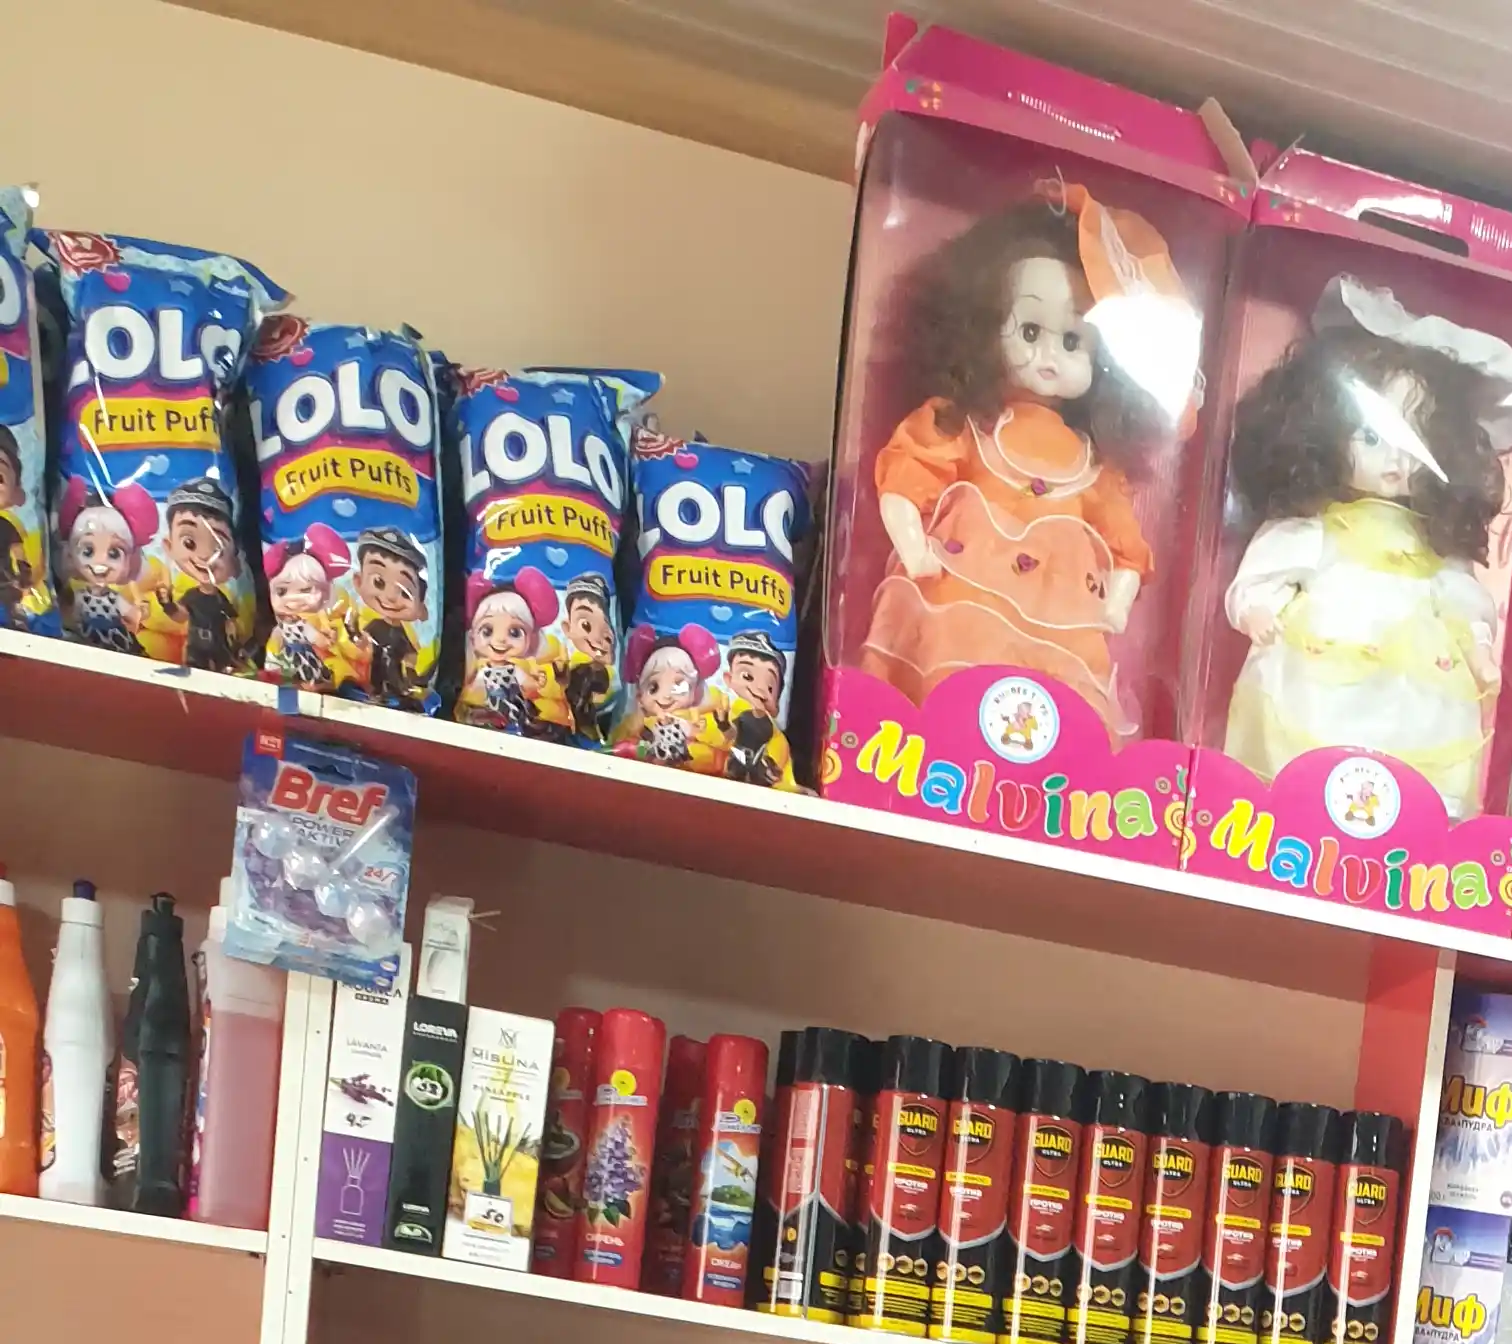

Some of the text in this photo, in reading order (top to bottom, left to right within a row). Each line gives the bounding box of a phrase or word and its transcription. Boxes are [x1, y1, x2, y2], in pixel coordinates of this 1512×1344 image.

[93, 408, 156, 436] Fruit
[285, 456, 412, 496] Fruit Puffs
[496, 505, 555, 532] Fruit
[661, 564, 786, 606] Fruit Puffs
[856, 720, 1158, 840] Malvina
[271, 767, 389, 825] Bref
[291, 816, 355, 838] POWER
[1210, 799, 1492, 911] Malvina
[897, 1110, 937, 1131] GUARD
[1033, 1130, 1073, 1152] GUARD
[1095, 1142, 1134, 1164] GUARD
[1153, 1154, 1193, 1174] GUARD
[1224, 1163, 1263, 1183] GUARD
